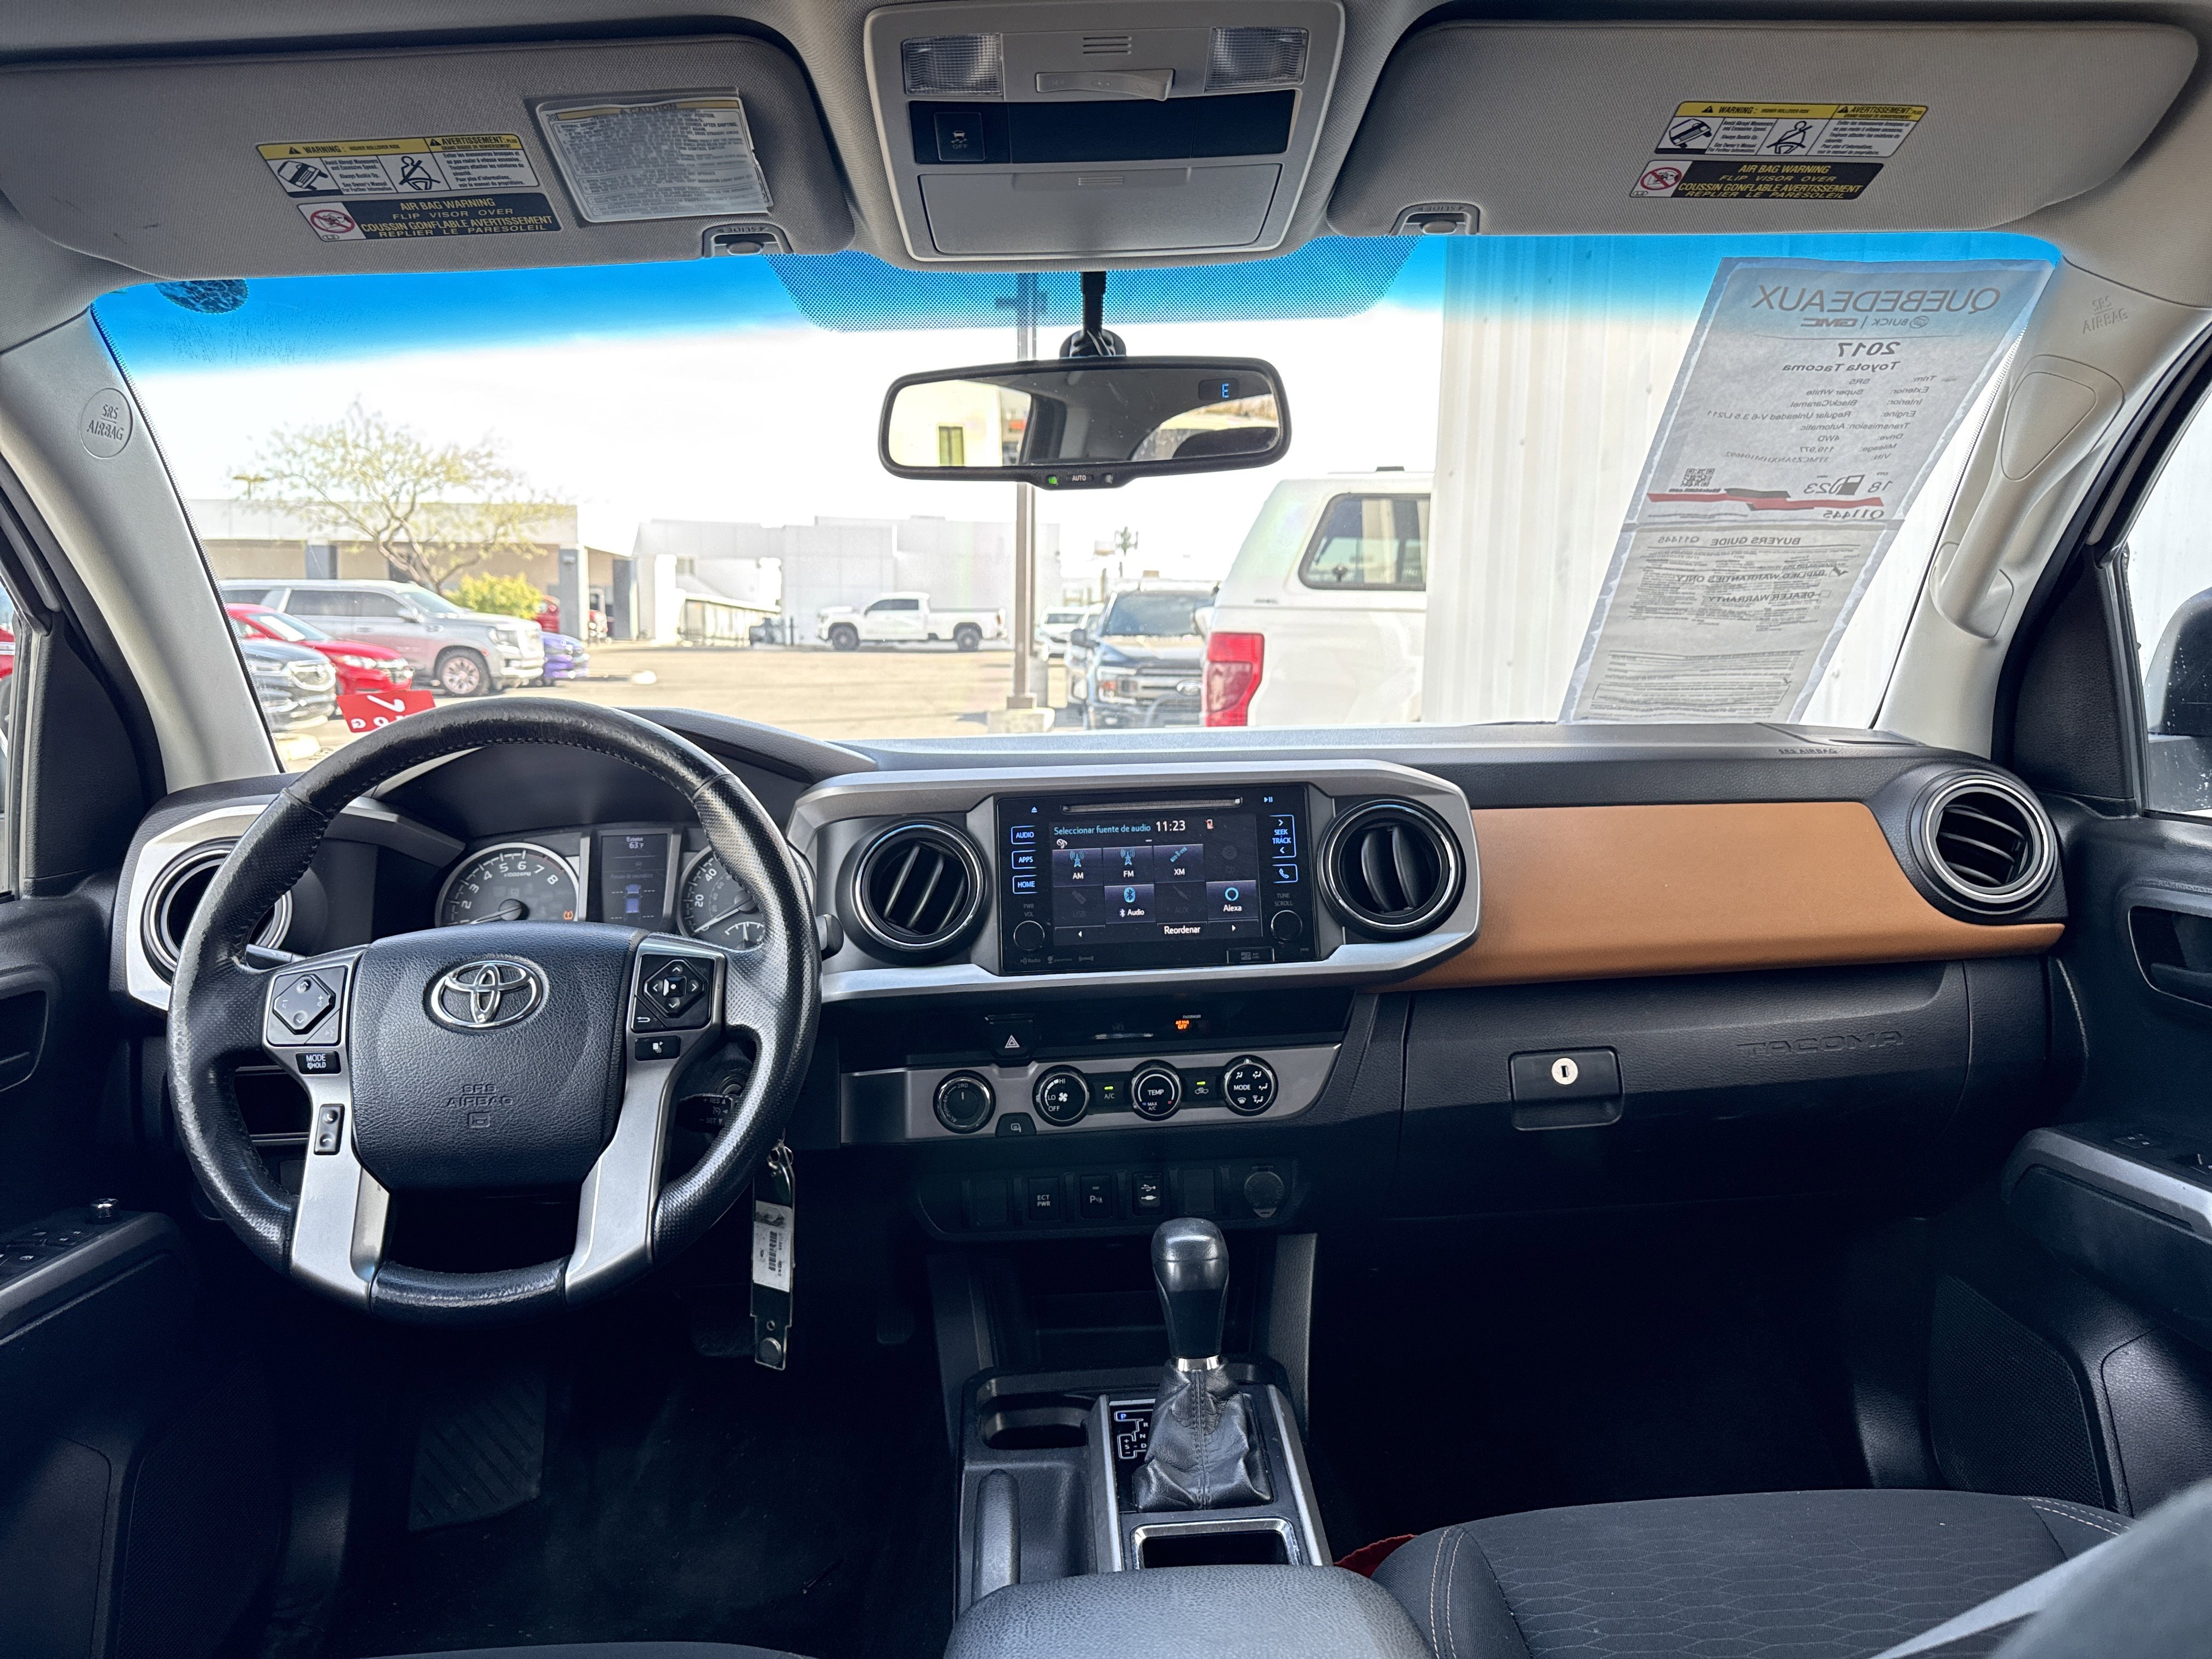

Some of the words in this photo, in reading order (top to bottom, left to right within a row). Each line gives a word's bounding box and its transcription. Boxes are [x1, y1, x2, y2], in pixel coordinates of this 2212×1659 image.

[1738, 165, 1762, 173] AIR
[1759, 165, 1782, 173] BAG
[1780, 165, 1831, 174] WARNING
[1678, 183, 1724, 191] COUSSIN
[1723, 183, 1780, 192] GONFLABLE
[1777, 184, 1864, 193] AVERTISSEMENT
[400, 201, 420, 211] AIR
[420, 200, 443, 211] BAG
[444, 198, 496, 210] WARNING
[430, 211, 470, 219] VISOR
[478, 208, 514, 216] OVER
[360, 221, 408, 233] COUSSIN
[409, 219, 471, 231] GONFLABLE
[470, 215, 552, 228] AVERTISSEMENT
[379, 229, 434, 238] REPLIER
[467, 224, 547, 234] PARESOLEIL
[2092, 296, 2112, 312] SRS
[2083, 308, 2129, 334] AIRBAG
[1221, 383, 1229, 399] E
[101, 403, 119, 420] SRS
[86, 419, 125, 441] AIRBAG
[1071, 474, 1087, 482] AUTO
[1053, 827, 1094, 836] Seleccionar
[1096, 825, 1119, 833] fuente
[1121, 825, 1130, 833] de
[1131, 823, 1152, 832] audio
[1156, 820, 1186, 832] 11:23
[499, 862, 509, 873] 5
[517, 861, 527, 870] 6
[534, 865, 545, 874] 7
[483, 870, 493, 881] 4
[548, 874, 558, 884] 8
[705, 868, 717, 882] 40
[1073, 872, 1084, 880] AM
[469, 883, 479, 894] 3
[461, 900, 472, 909] 2
[695, 894, 704, 907] 20
[1127, 908, 1146, 917] Audio
[1164, 925, 1201, 934] Reordenar
[1736, 1030, 1904, 1058] TACOMA
[306, 1053, 326, 1062] MODE
[462, 1083, 497, 1094] SRS
[445, 1096, 514, 1108] AIRBAG
